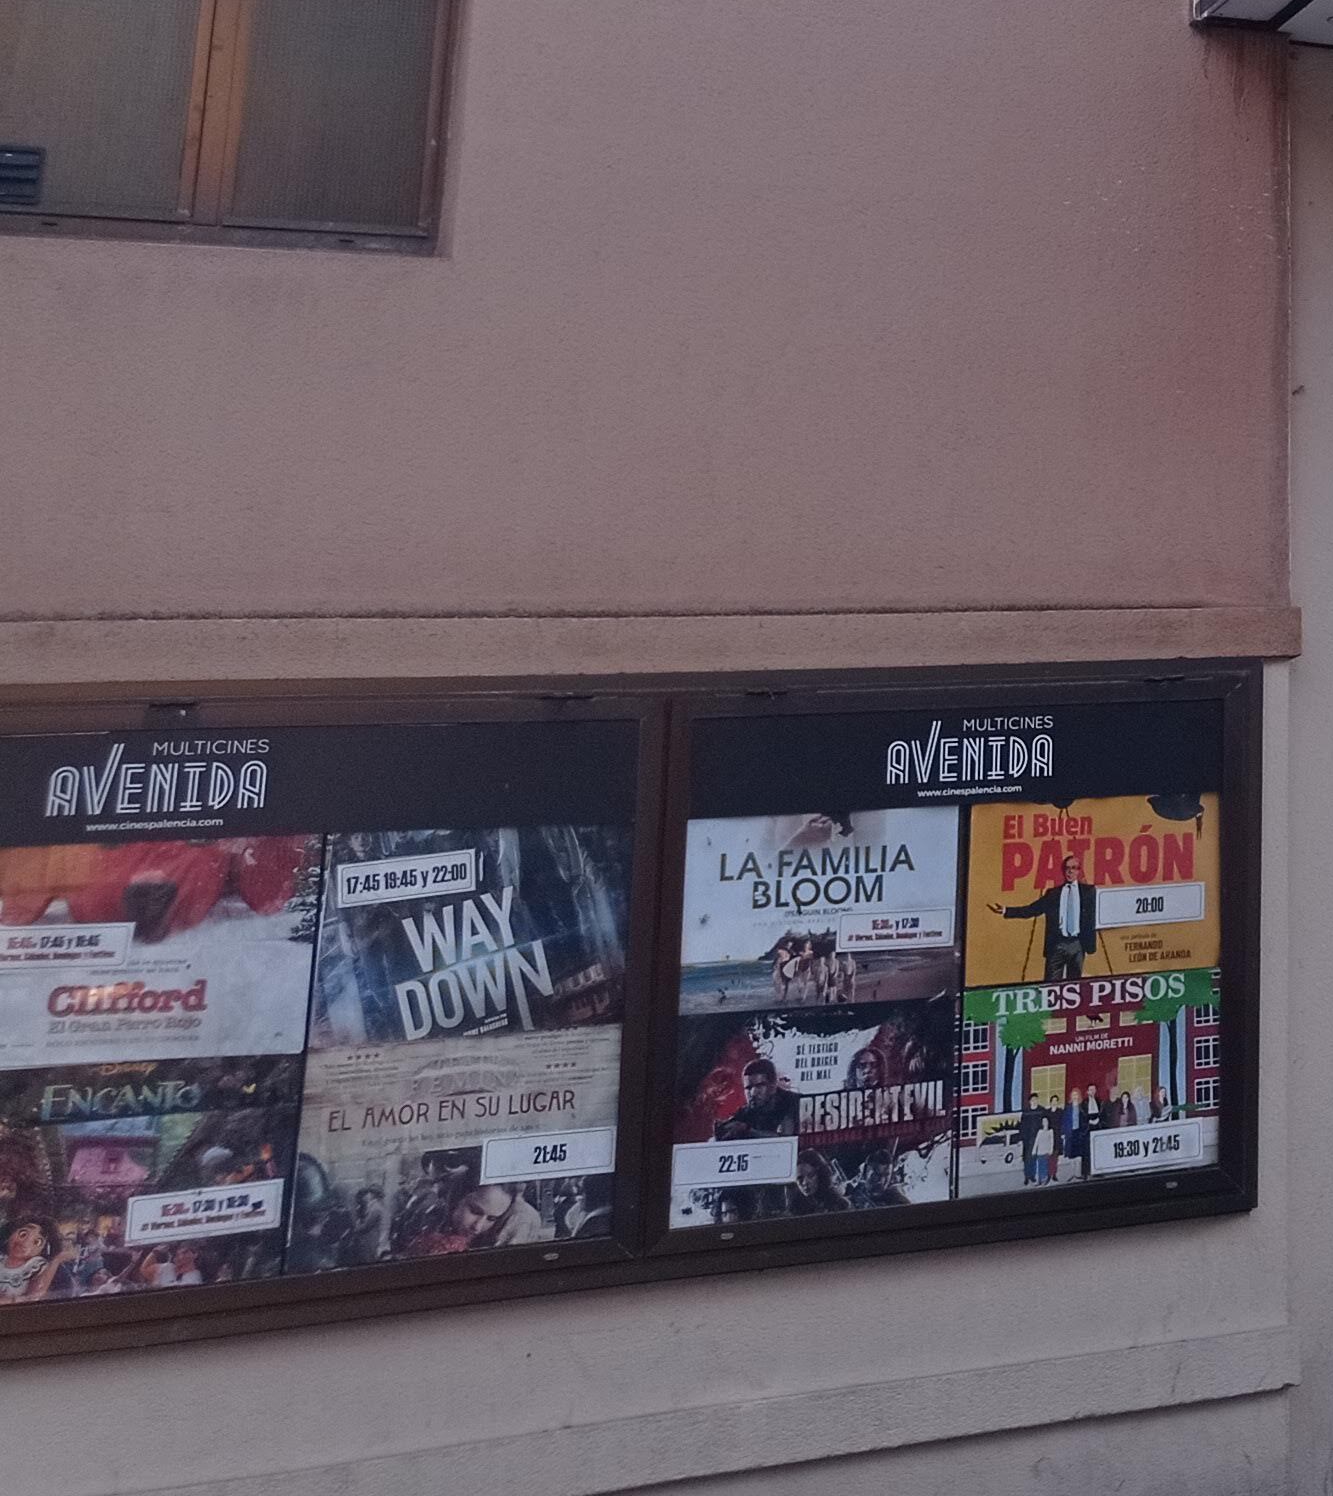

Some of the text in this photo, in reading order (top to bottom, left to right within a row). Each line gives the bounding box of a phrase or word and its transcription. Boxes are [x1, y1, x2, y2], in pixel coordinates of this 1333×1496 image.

[962, 715, 1054, 732] MULTICINES
[152, 738, 271, 756] MULTICINES
[886, 720, 1053, 785] AVENIDA
[44, 743, 268, 818] AVENIDA
[917, 785, 1023, 798] www.cinespalencia.com
[86, 817, 224, 832] www.cinespalencia.com
[1003, 813, 1093, 840] El Buen
[720, 843, 916, 882] LA FAMILIA
[1001, 824, 1194, 892] PATRÓN
[346, 862, 468, 895] 17:45 19:45 y 22:00
[752, 874, 885, 910] BLOOM
[1135, 896, 1165, 915] 20:00
[401, 886, 516, 974] WAY
[1124, 939, 1163, 952] FERNANDO
[1148, 950, 1158, 962] DE
[47, 978, 208, 1018] Clifford
[394, 938, 554, 1042] DOWN
[991, 973, 1186, 1016] TRES PISOS
[808, 1041, 839, 1053] TESTIGO
[1048, 1036, 1134, 1055] NANNI MORETTI
[1085, 1033, 1100, 1041] FILM
[795, 1055, 839, 1069] DEL ORIGEN
[800, 1069, 832, 1082] DEL MAL
[40, 1079, 202, 1122] ENCANTO
[327, 1089, 576, 1133] EL AMOR EN SU LUGAR
[800, 1085, 901, 1134] RESIDENT
[902, 1079, 946, 1122] EVIL
[533, 1143, 567, 1166] 21:45
[1113, 1134, 1181, 1159] 19:30 y 21:45
[718, 1154, 750, 1174] 22:15
